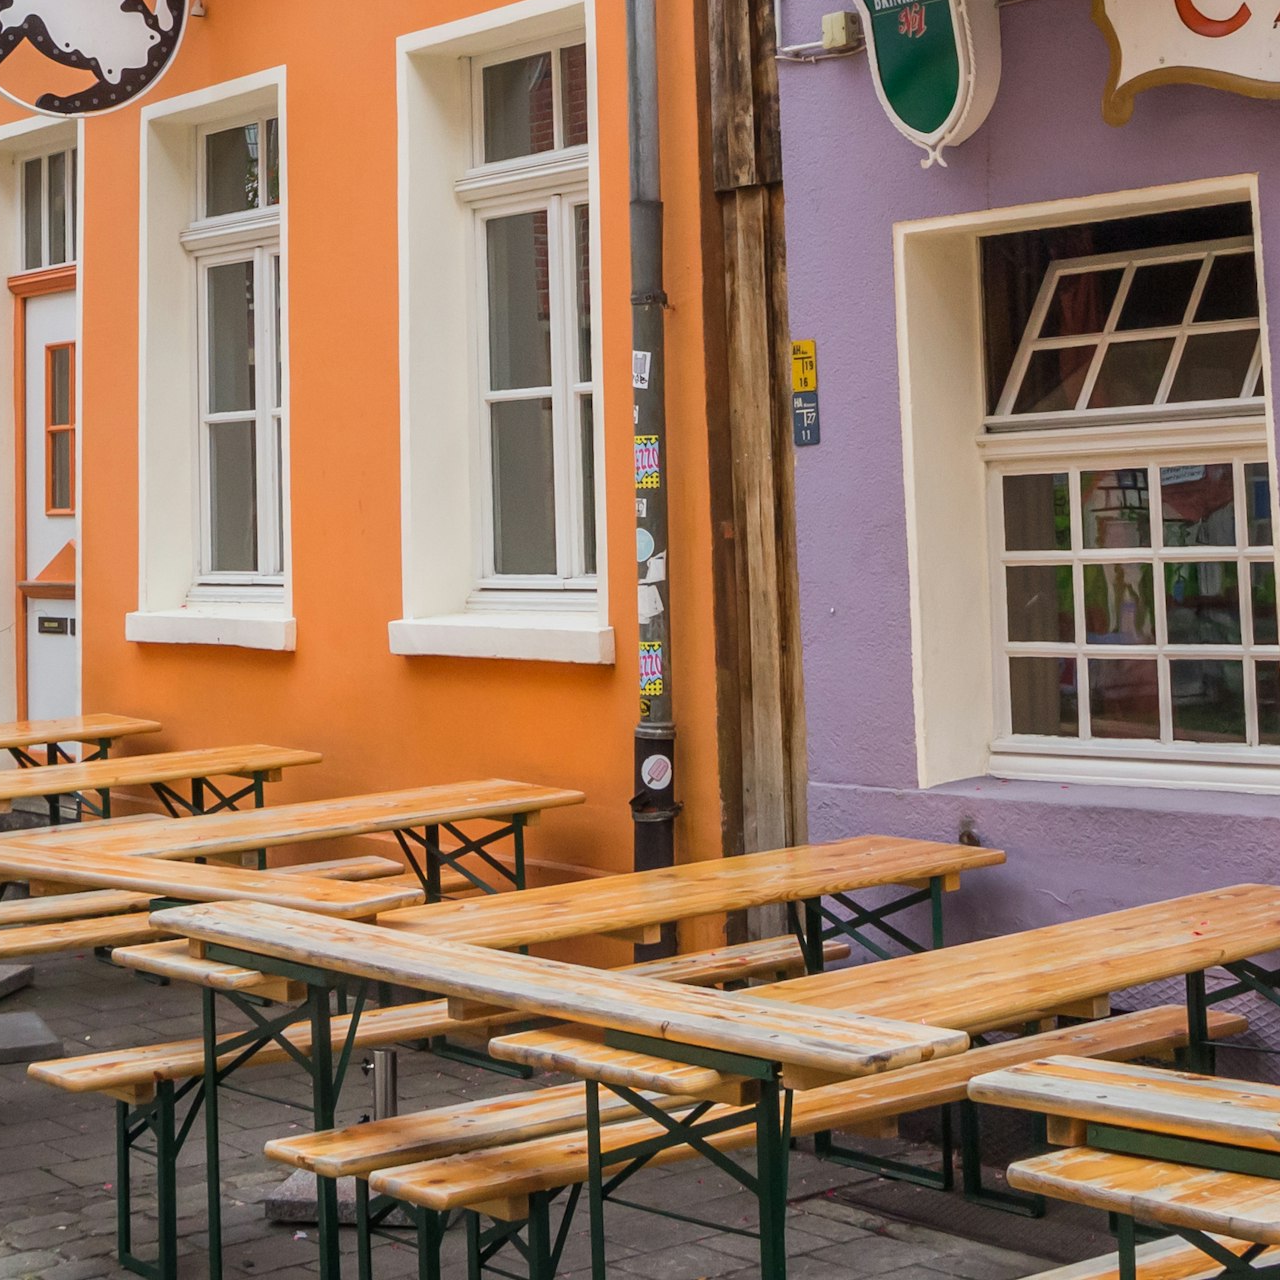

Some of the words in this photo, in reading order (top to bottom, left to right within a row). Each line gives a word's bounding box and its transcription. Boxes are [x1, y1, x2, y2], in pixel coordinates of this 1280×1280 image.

[805, 360, 814, 371] 19
[799, 377, 808, 387] 16
[806, 412, 816, 425] 27
[801, 429, 811, 441] 11
